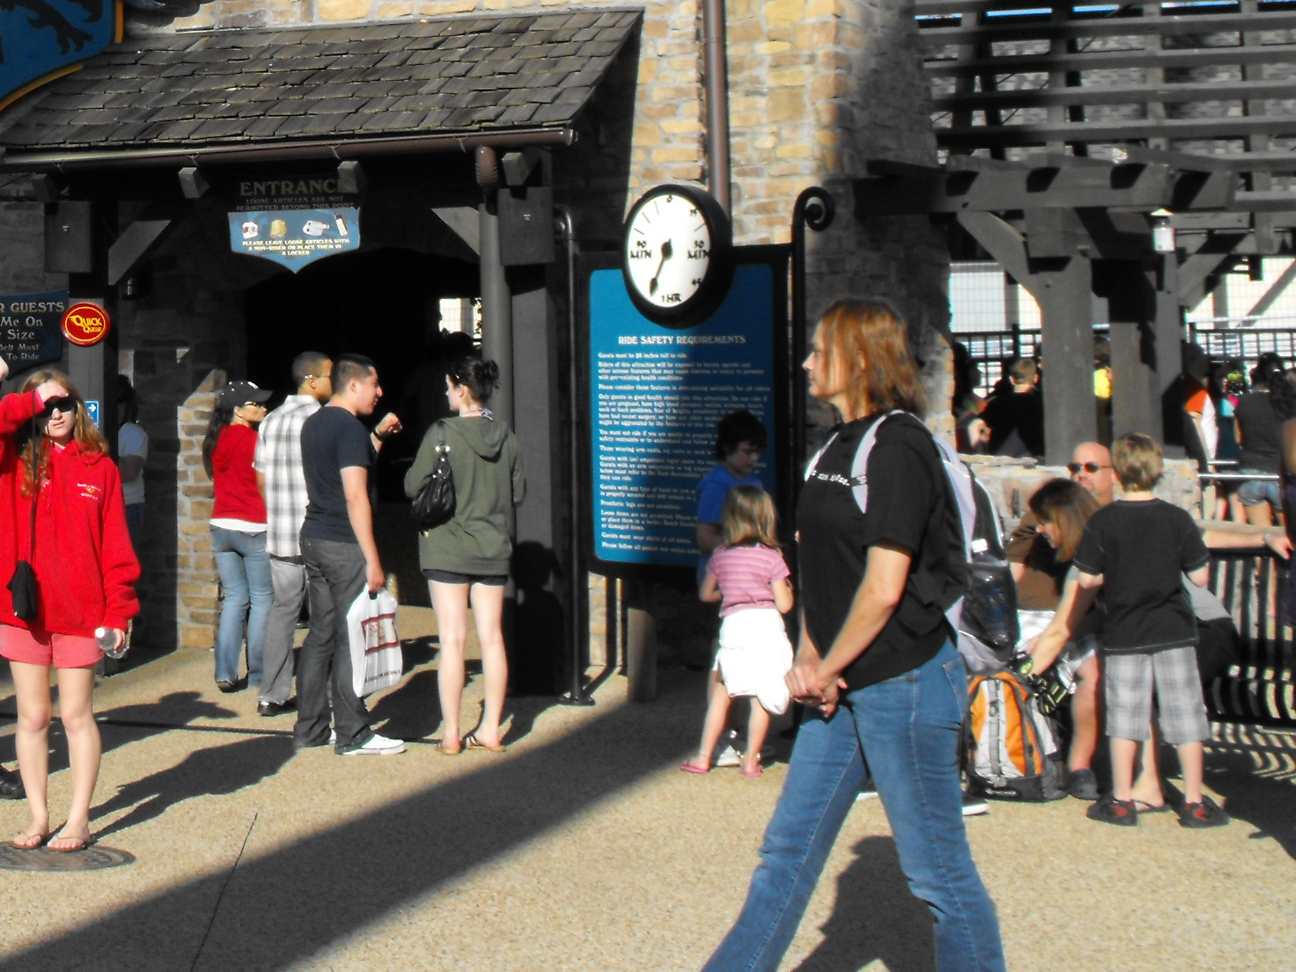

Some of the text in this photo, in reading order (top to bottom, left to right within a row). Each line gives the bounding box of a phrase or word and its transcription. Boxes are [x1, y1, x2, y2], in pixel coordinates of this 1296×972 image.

[630, 249, 652, 259] MIN
[688, 249, 710, 259] MIN
[9, 301, 65, 314] GUESTS
[1, 316, 20, 327] Me
[25, 316, 44, 327] On
[7, 329, 35, 340] Size
[618, 335, 746, 346] RIDE SAFETY REQUIREMENTS
[17, 343, 40, 351] Must
[7, 352, 40, 360] To Ride
